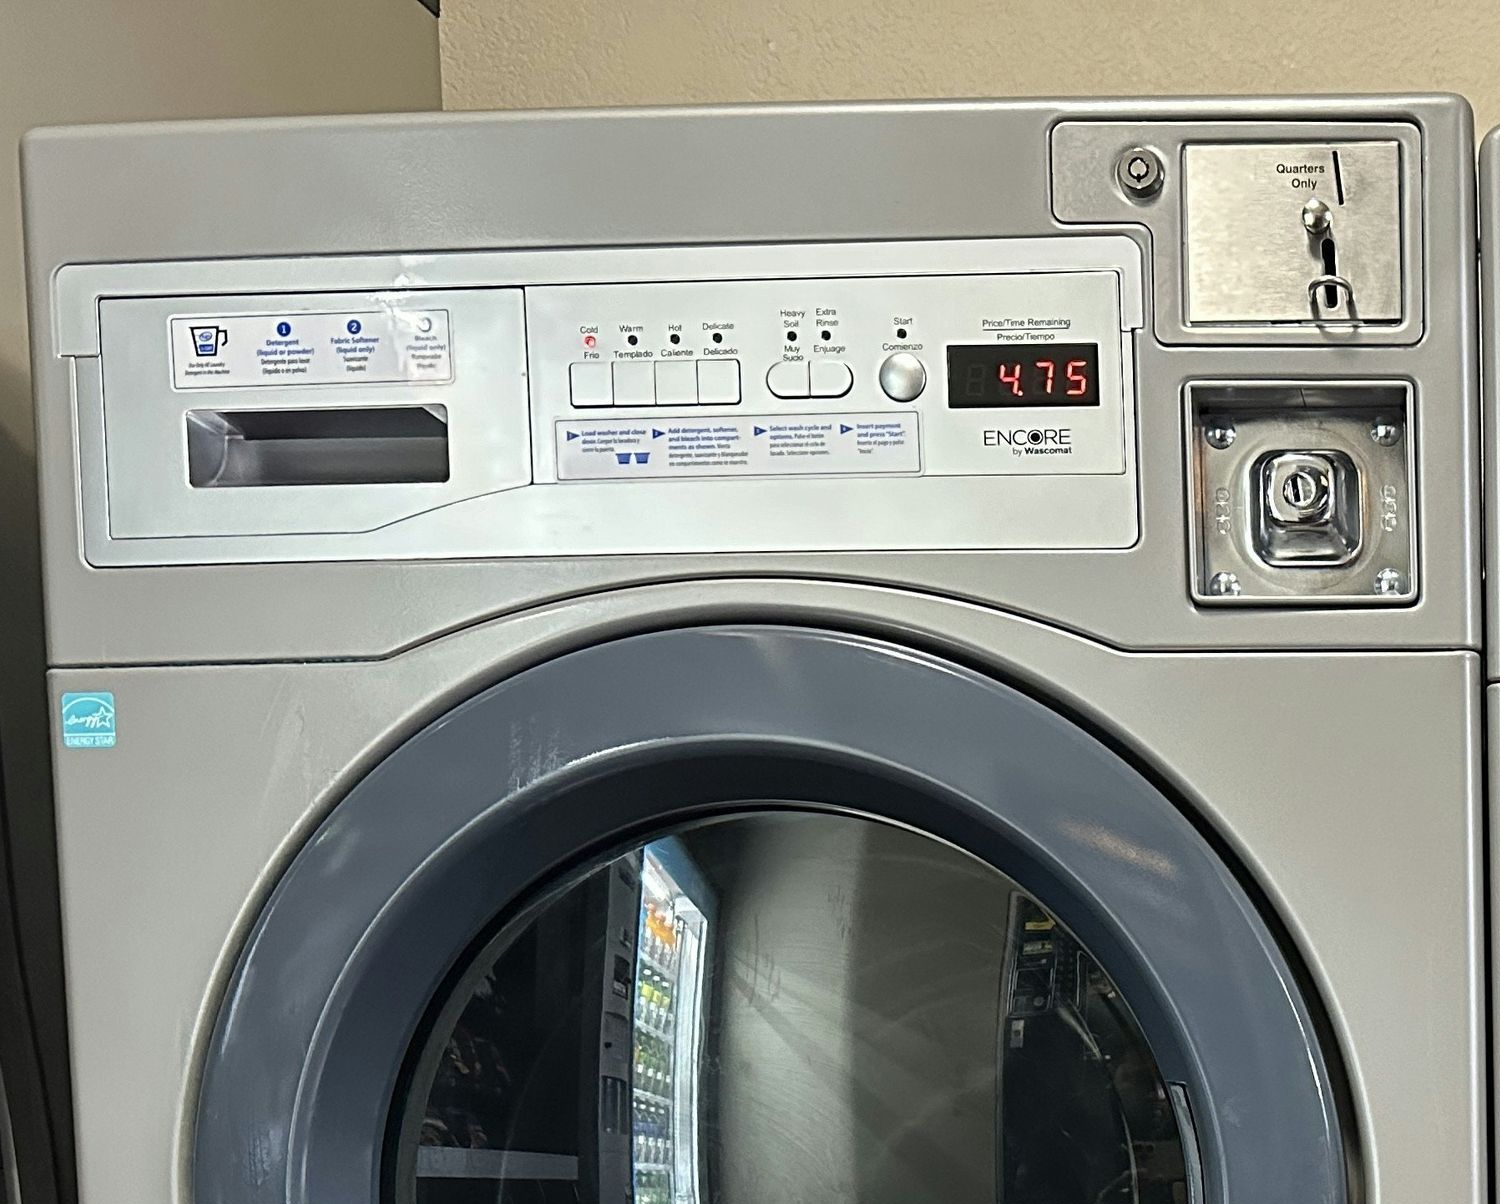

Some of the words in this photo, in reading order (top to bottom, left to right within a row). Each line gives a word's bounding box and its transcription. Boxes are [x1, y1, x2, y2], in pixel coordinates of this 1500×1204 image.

[1276, 164, 1325, 174] Quarters
[1292, 178, 1317, 190] Only
[780, 309, 805, 318] Heavy
[816, 308, 836, 316] Extra
[784, 320, 799, 328] Soil
[894, 317, 912, 325] Start
[982, 319, 1025, 327] Price/Time
[1027, 318, 1071, 329] Remaining
[580, 326, 598, 334] Cold
[359, 346, 375, 354] only)
[784, 345, 800, 353] Muy
[814, 345, 846, 354] Enjuage
[882, 343, 923, 351] Comienzo
[287, 348, 314, 356] powder)
[661, 349, 693, 357] Caliente
[999, 362, 1087, 396] 4.75
[984, 429, 1071, 446] ENCORE
[1012, 448, 1022, 457] by
[66, 737, 94, 745] ENERGY
